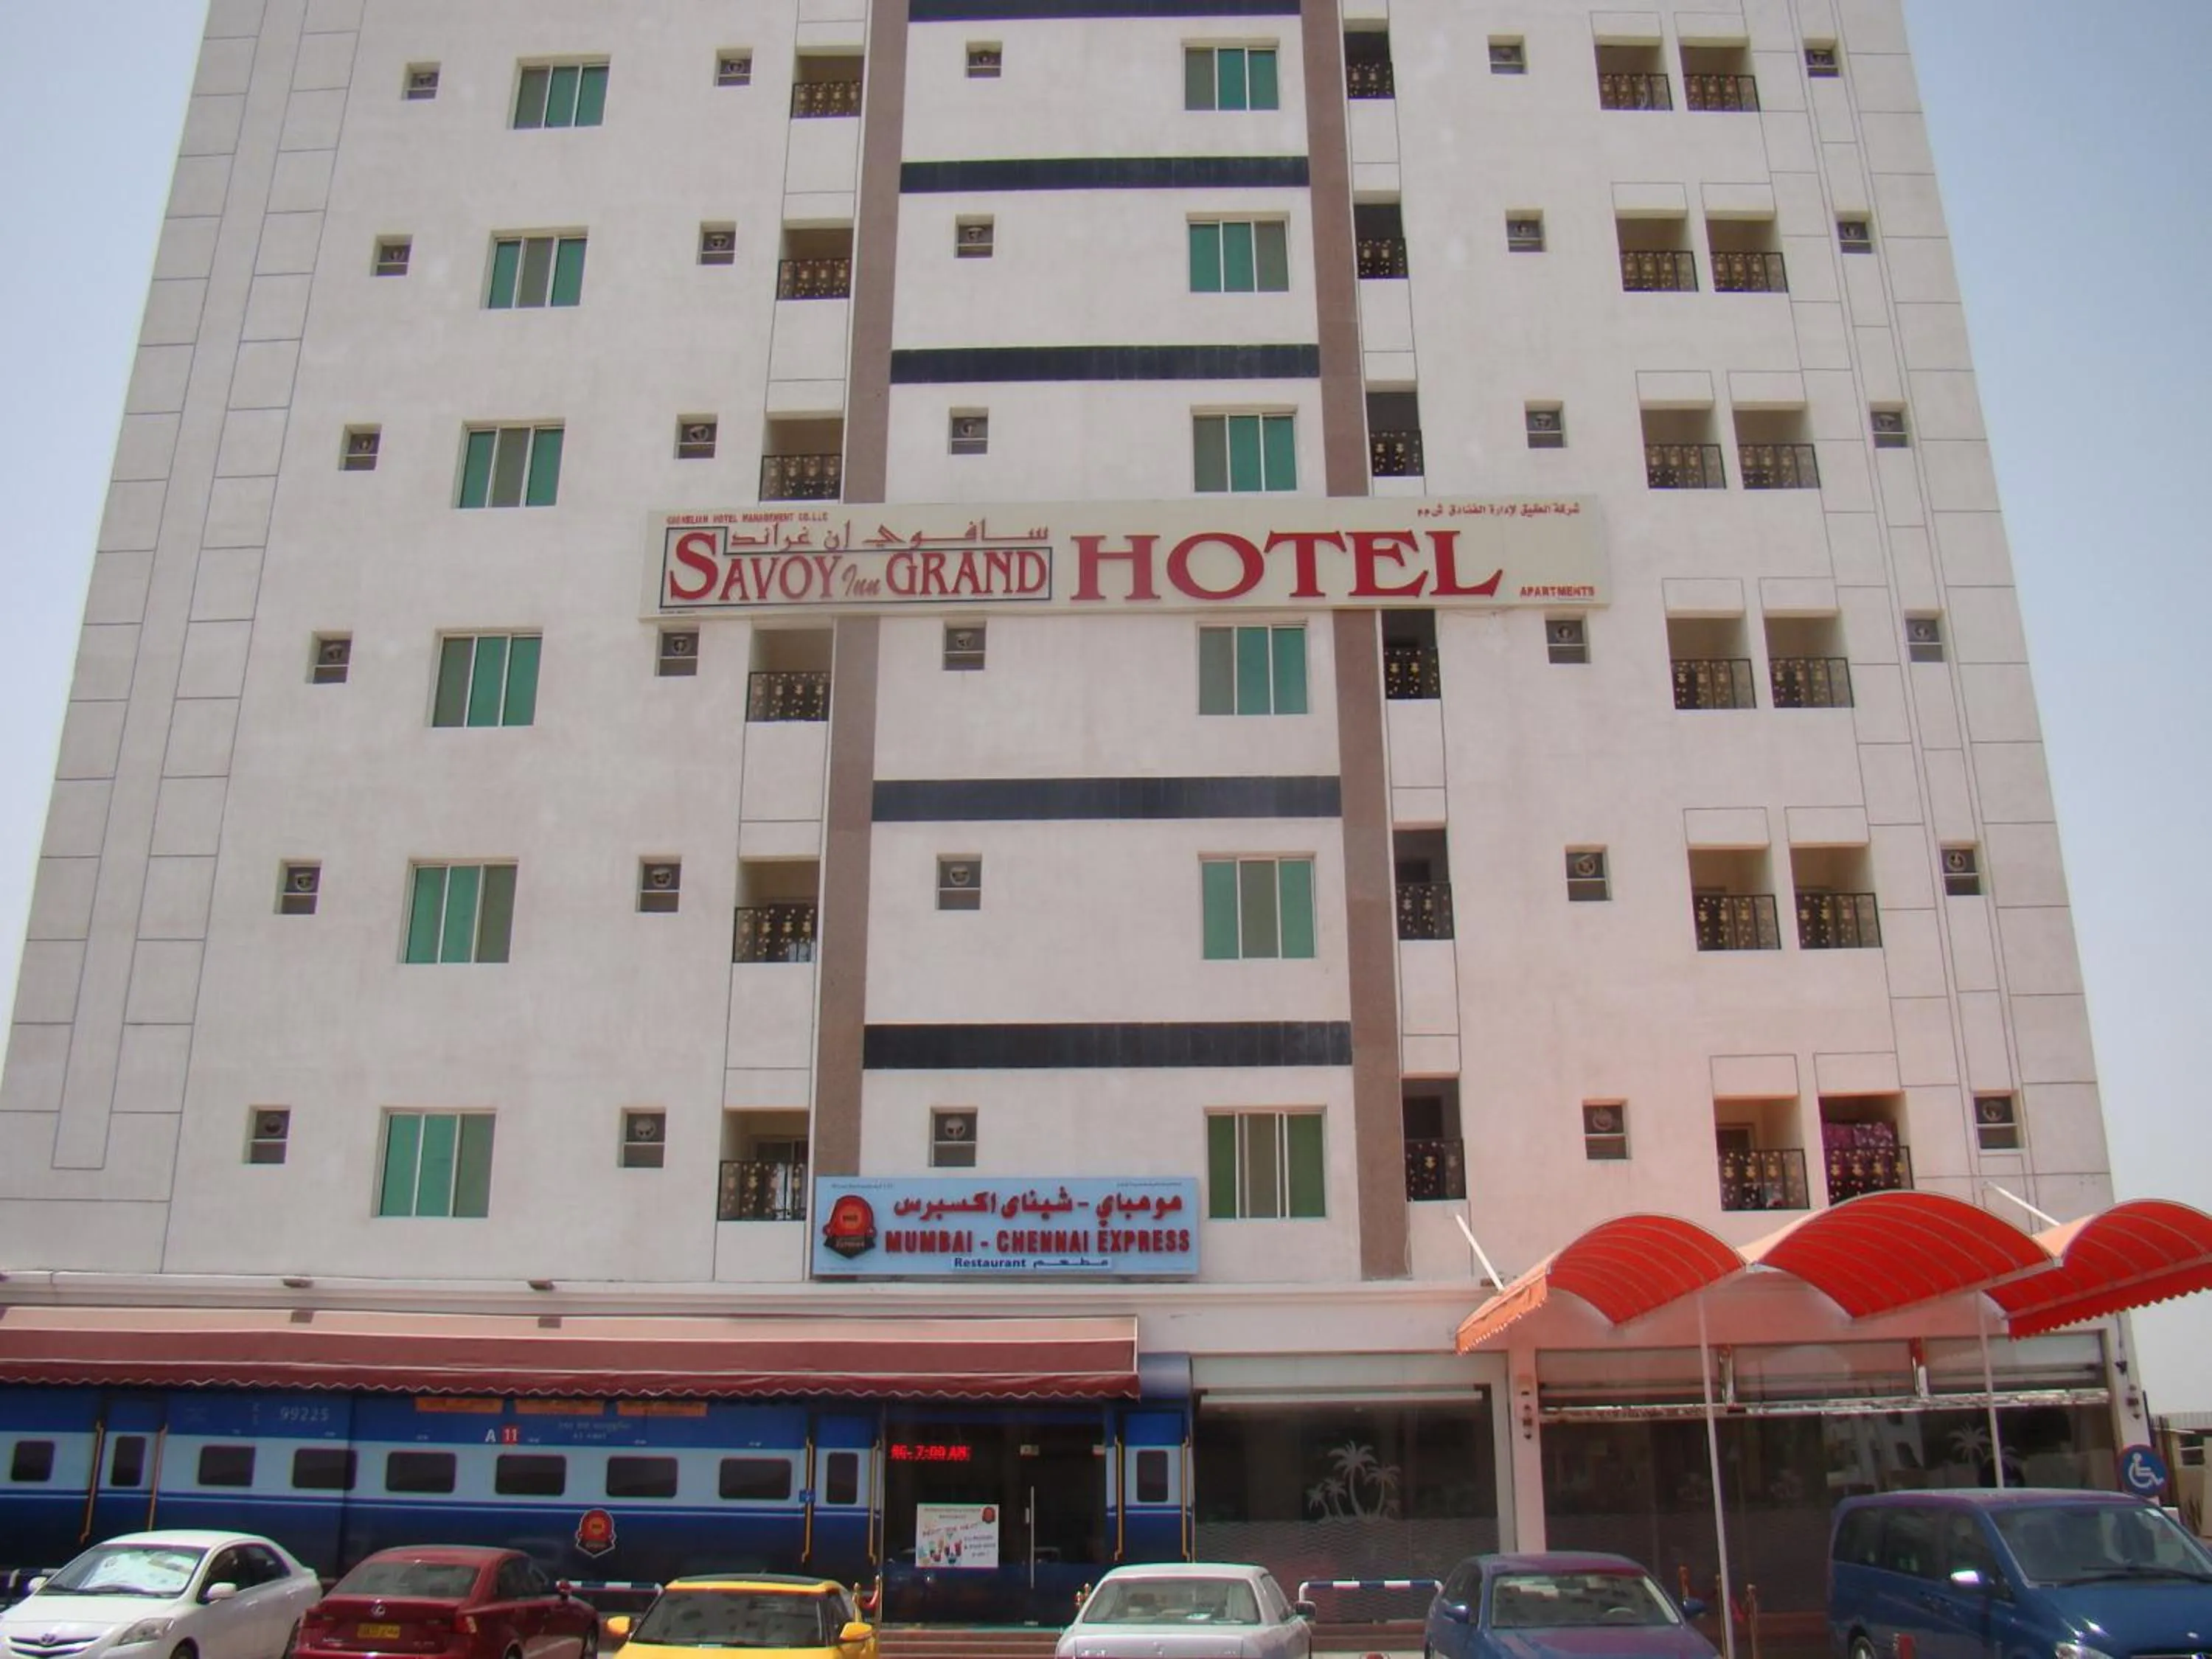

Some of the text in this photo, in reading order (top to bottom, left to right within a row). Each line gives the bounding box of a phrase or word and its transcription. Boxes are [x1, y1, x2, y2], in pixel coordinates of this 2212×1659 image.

[731, 522, 813, 553] غراند
[669, 531, 1048, 602] SAVOY Inn GRAND
[1070, 529, 1503, 601] HOTEL
[1520, 585, 1594, 597] APARTMENTS
[886, 1229, 973, 1253] MUMBAI
[996, 1229, 1089, 1253] CHENNAI
[1097, 1229, 1190, 1253] EXPRESS
[954, 1257, 1027, 1268] Restaurant
[484, 1428, 496, 1443] A
